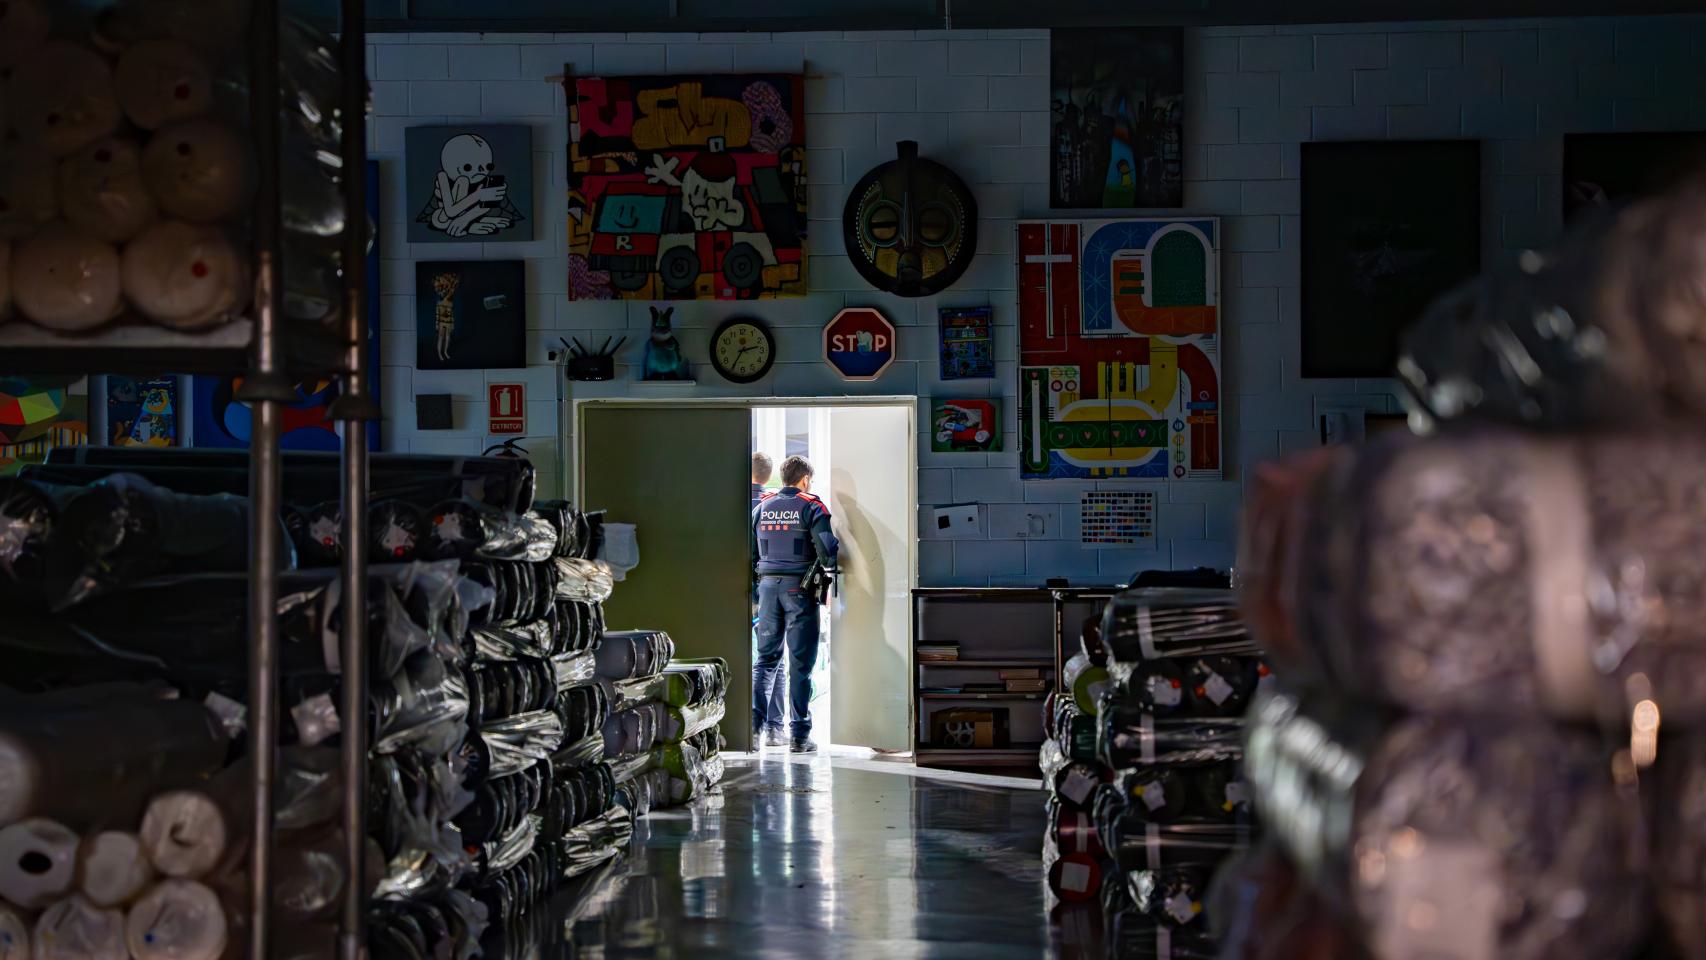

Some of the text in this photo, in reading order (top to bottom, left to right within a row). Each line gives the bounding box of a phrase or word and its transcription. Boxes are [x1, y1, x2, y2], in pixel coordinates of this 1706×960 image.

[616, 236, 632, 250] R
[832, 334, 887, 352] STP
[761, 511, 799, 519] POLICIA
